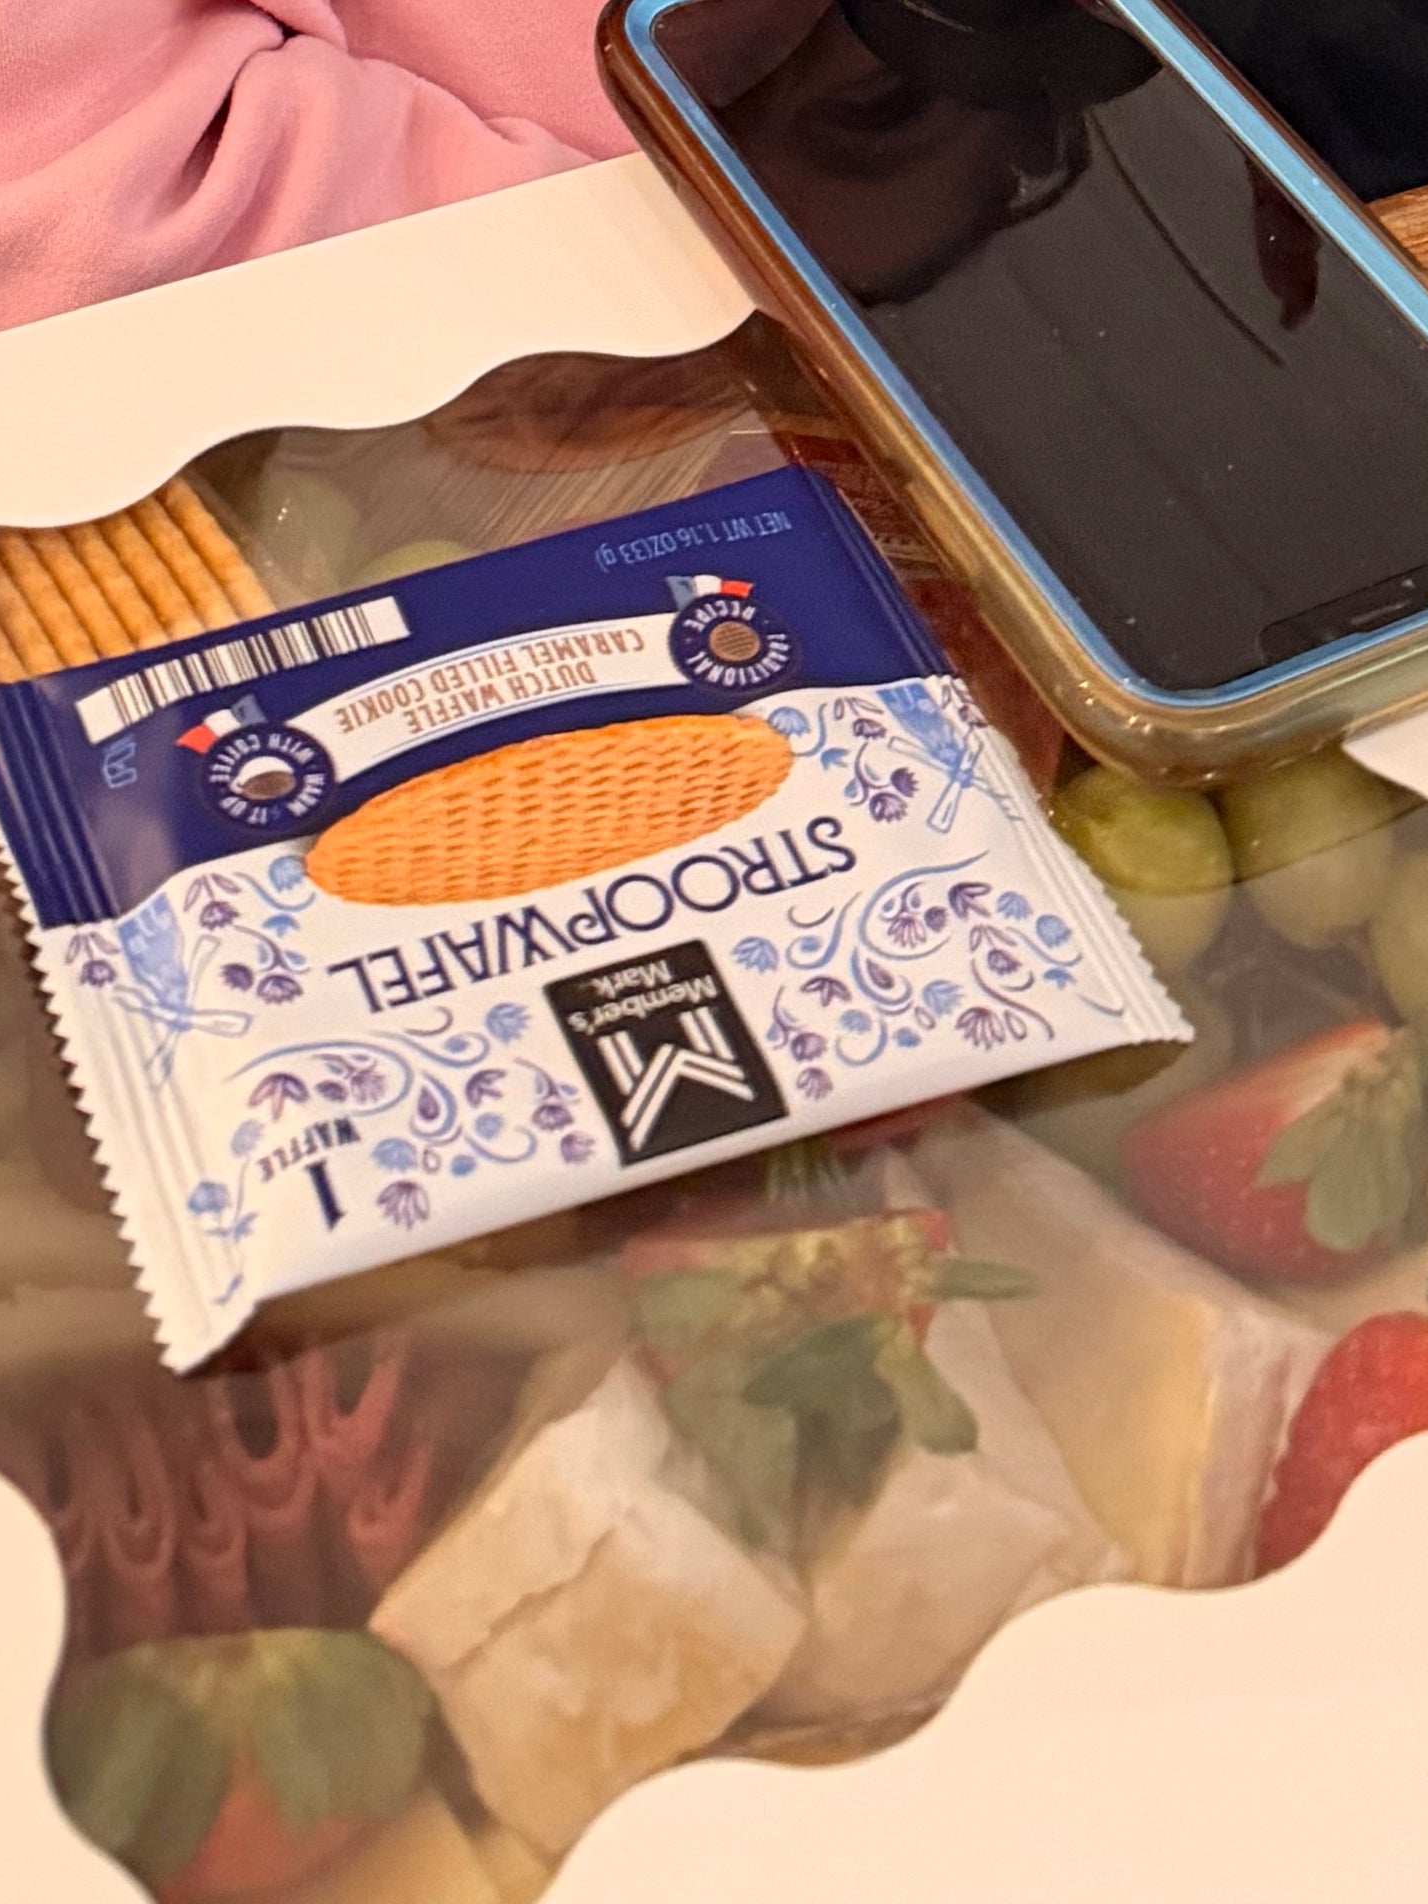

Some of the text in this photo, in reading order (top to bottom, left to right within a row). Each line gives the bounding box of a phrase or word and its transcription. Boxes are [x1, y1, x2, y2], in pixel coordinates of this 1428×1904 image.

[678, 522, 721, 548] 1.16
[722, 516, 753, 542] WT
[753, 511, 792, 537] NET
[682, 599, 757, 632] RECIPE
[336, 628, 645, 734] CARAMEL FILLED COOKIE
[685, 633, 790, 686] TRADITIONAL
[402, 660, 598, 735] DUTCH WAFFLE
[327, 816, 857, 1013] STROOPWAFEL
[567, 974, 718, 1036] Member's
[590, 959, 674, 999] Mark
[257, 1116, 362, 1183] WAFFLE
[303, 1158, 347, 1231] 1
